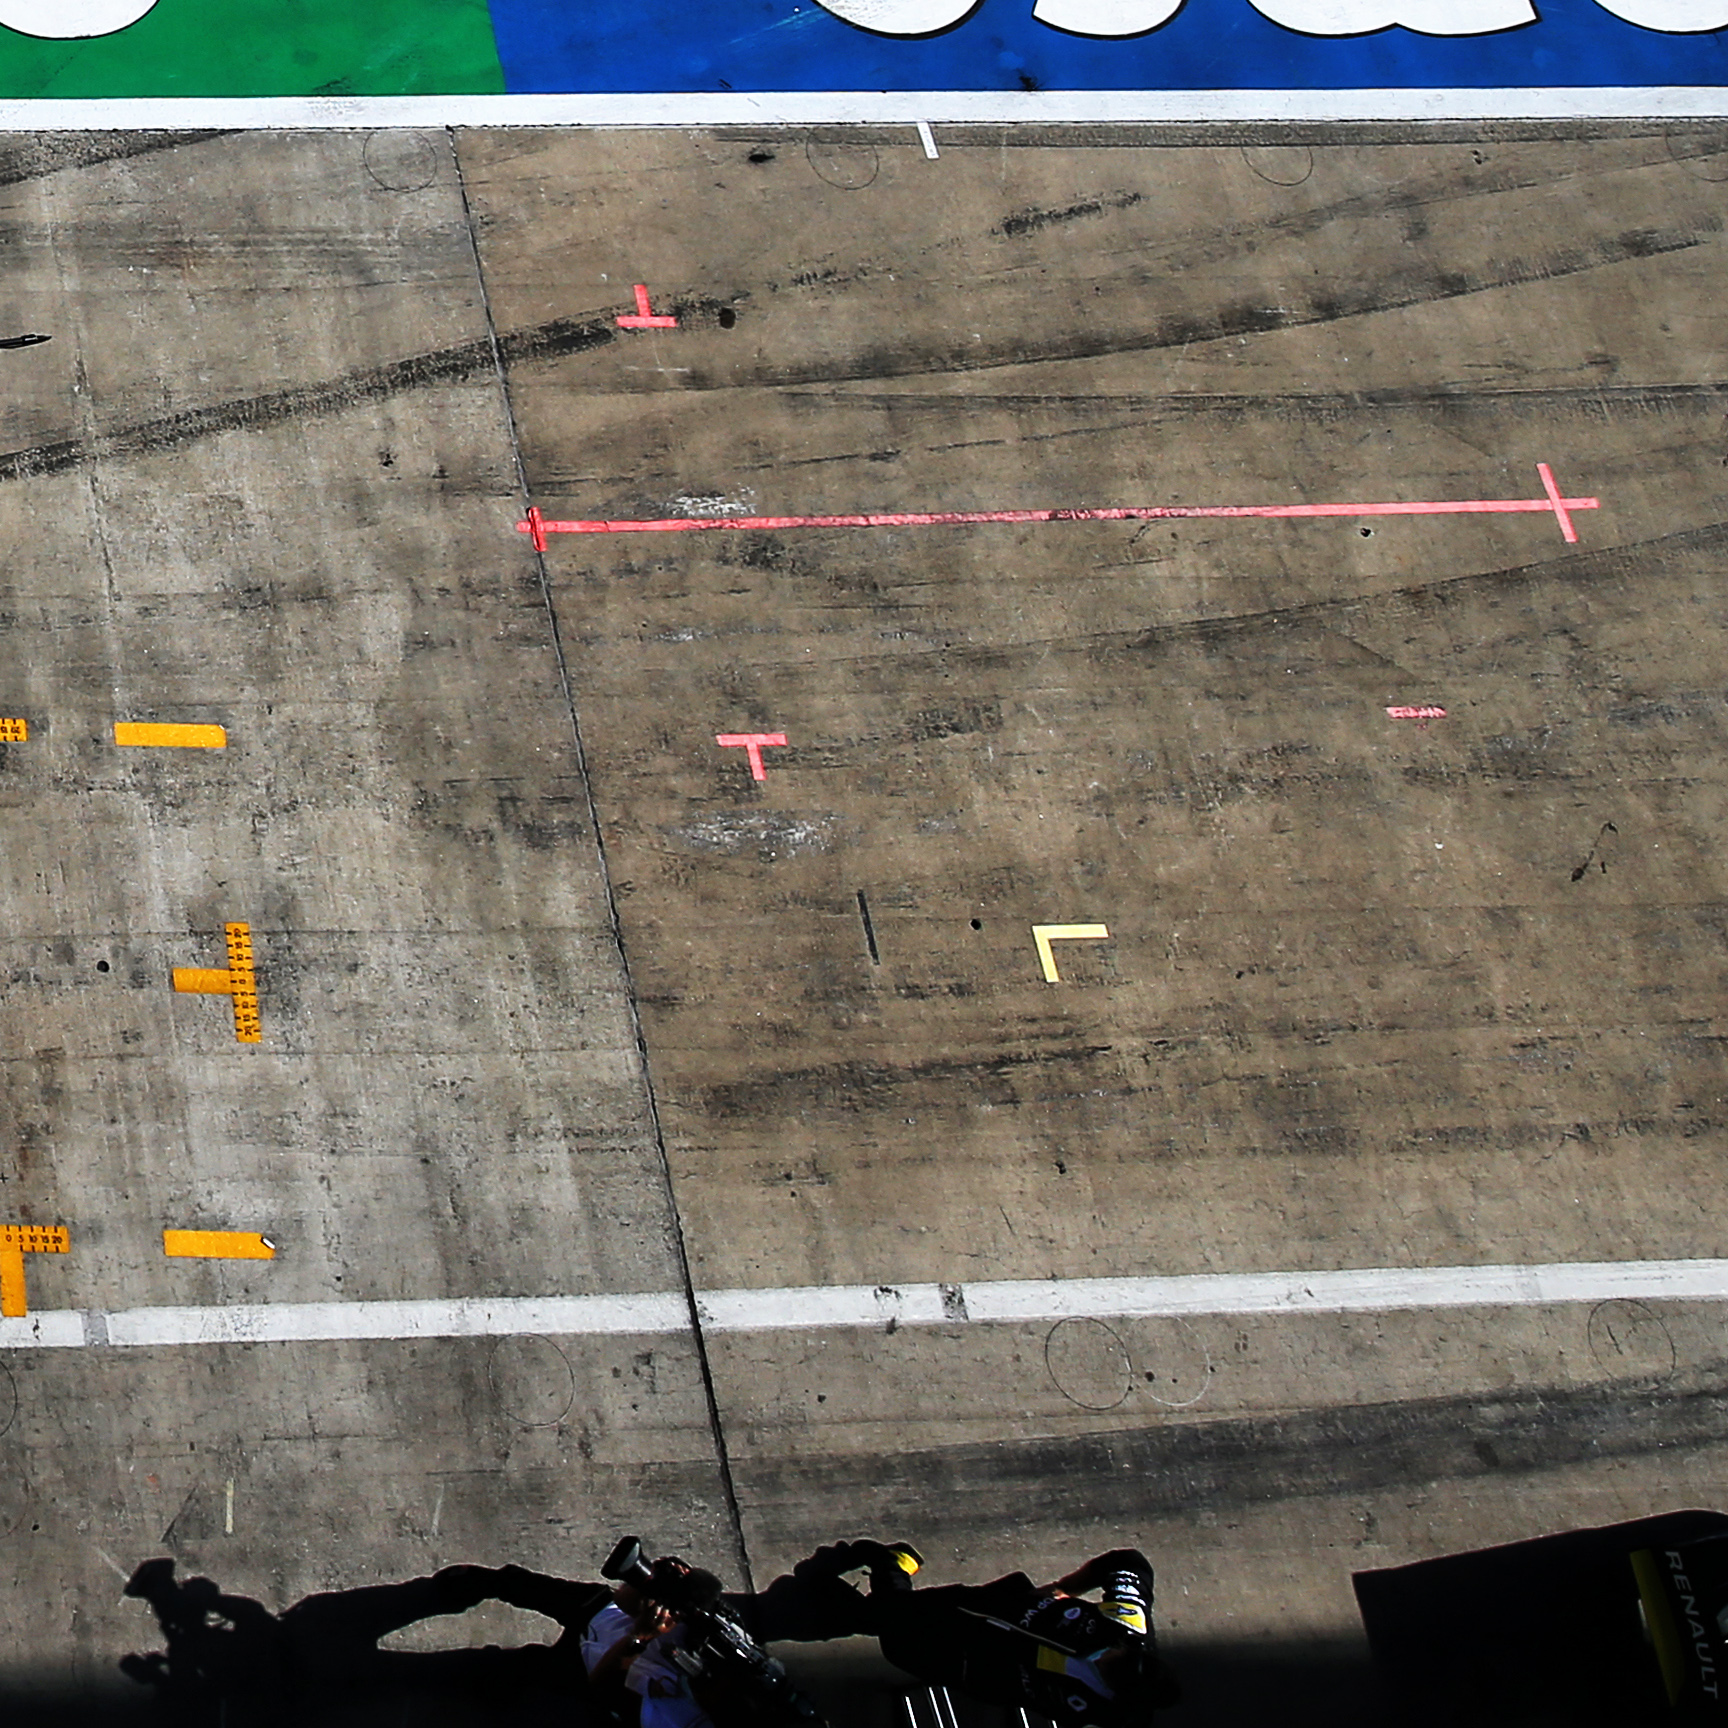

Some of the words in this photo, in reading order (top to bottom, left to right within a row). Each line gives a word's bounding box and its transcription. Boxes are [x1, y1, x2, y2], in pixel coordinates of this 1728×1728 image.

[5, 1234, 12, 1242] 0
[18, 1234, 24, 1243] 5
[29, 1235, 38, 1243] 10
[40, 1235, 50, 1244] 15
[51, 1235, 63, 1244] 20
[1664, 1550, 1719, 1700] RENAULT
